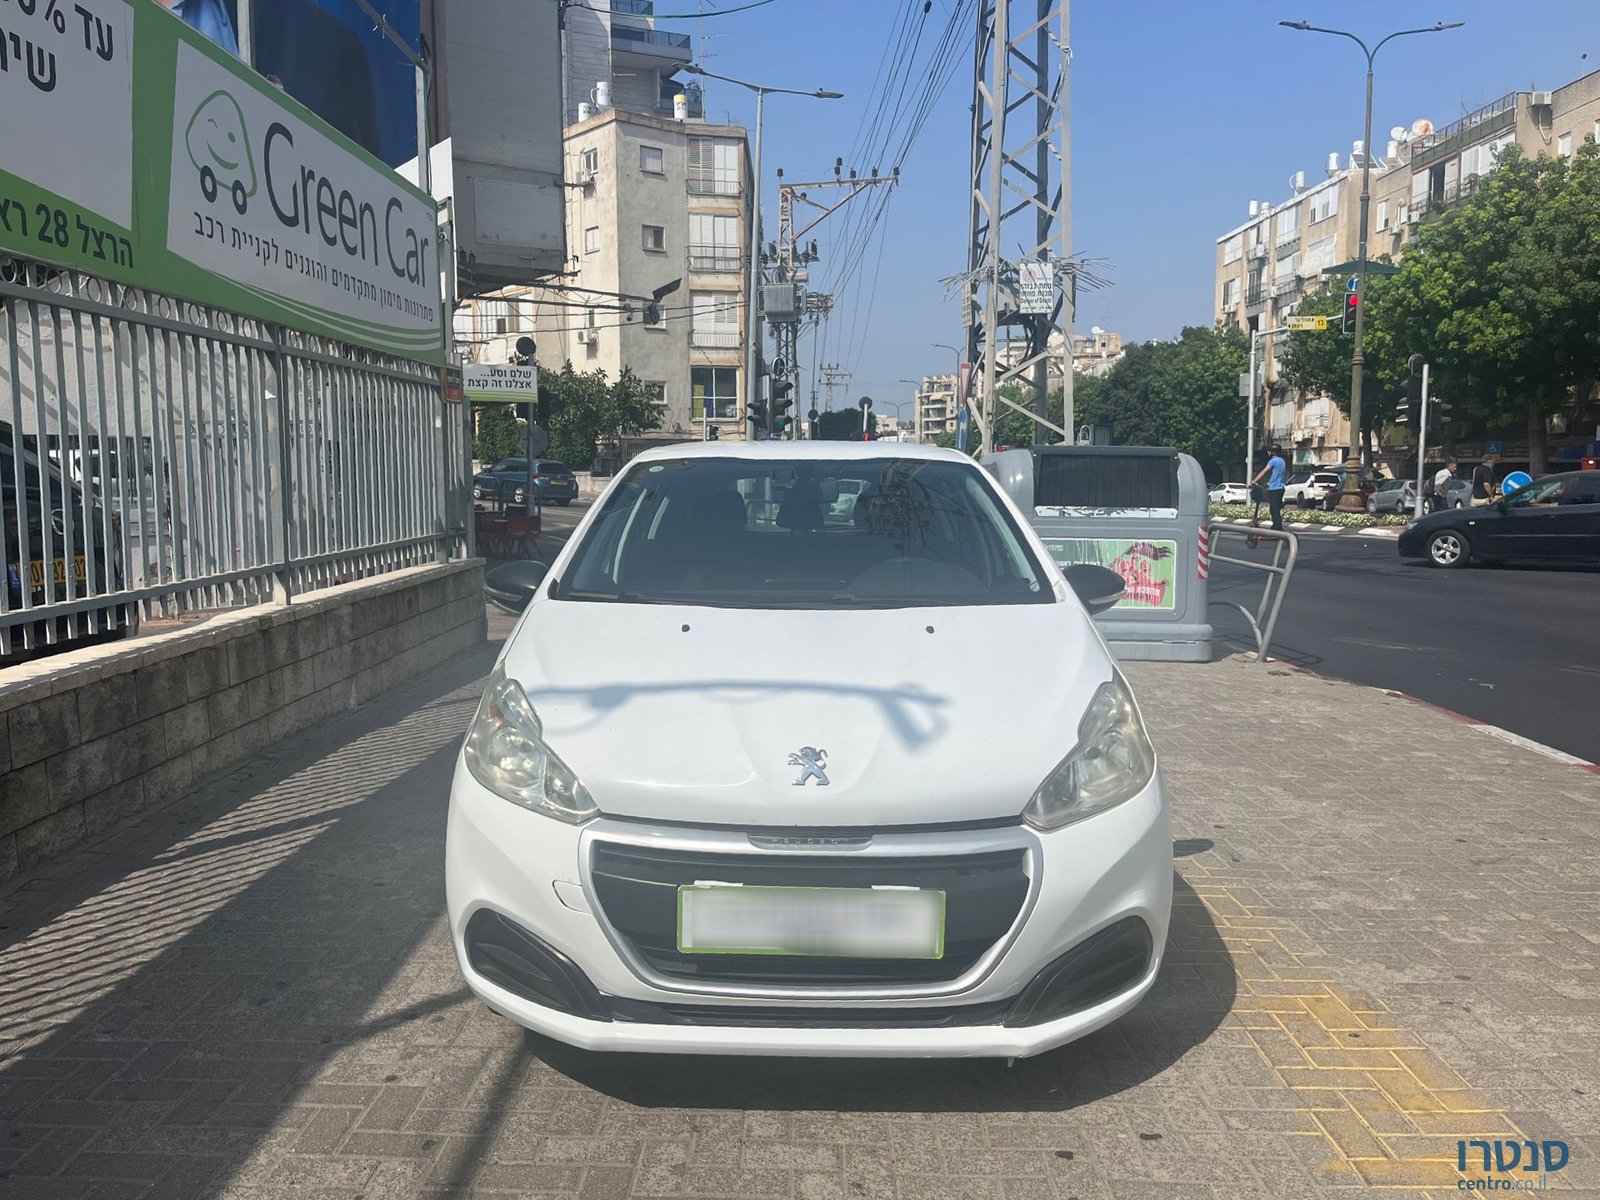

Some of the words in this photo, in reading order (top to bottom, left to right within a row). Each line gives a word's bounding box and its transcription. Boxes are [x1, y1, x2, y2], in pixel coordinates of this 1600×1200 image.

[75, 3, 114, 61] עד
[264, 122, 378, 267] Green
[385, 197, 429, 288] Car
[36, 203, 70, 248] 28
[76, 213, 134, 268] הרצל
[194, 211, 225, 244] רכב
[231, 226, 279, 266] לקניית
[285, 249, 328, 283] והוגנים
[331, 268, 377, 301] מתקדמים
[379, 287, 402, 311] מימון
[404, 298, 434, 323] פתרונות
[467, 379, 489, 389] קצת
[480, 369, 507, 378] וסע...
[492, 380, 502, 388] זה
[505, 379, 532, 389] אצלנו
[510, 369, 532, 379] שלם
